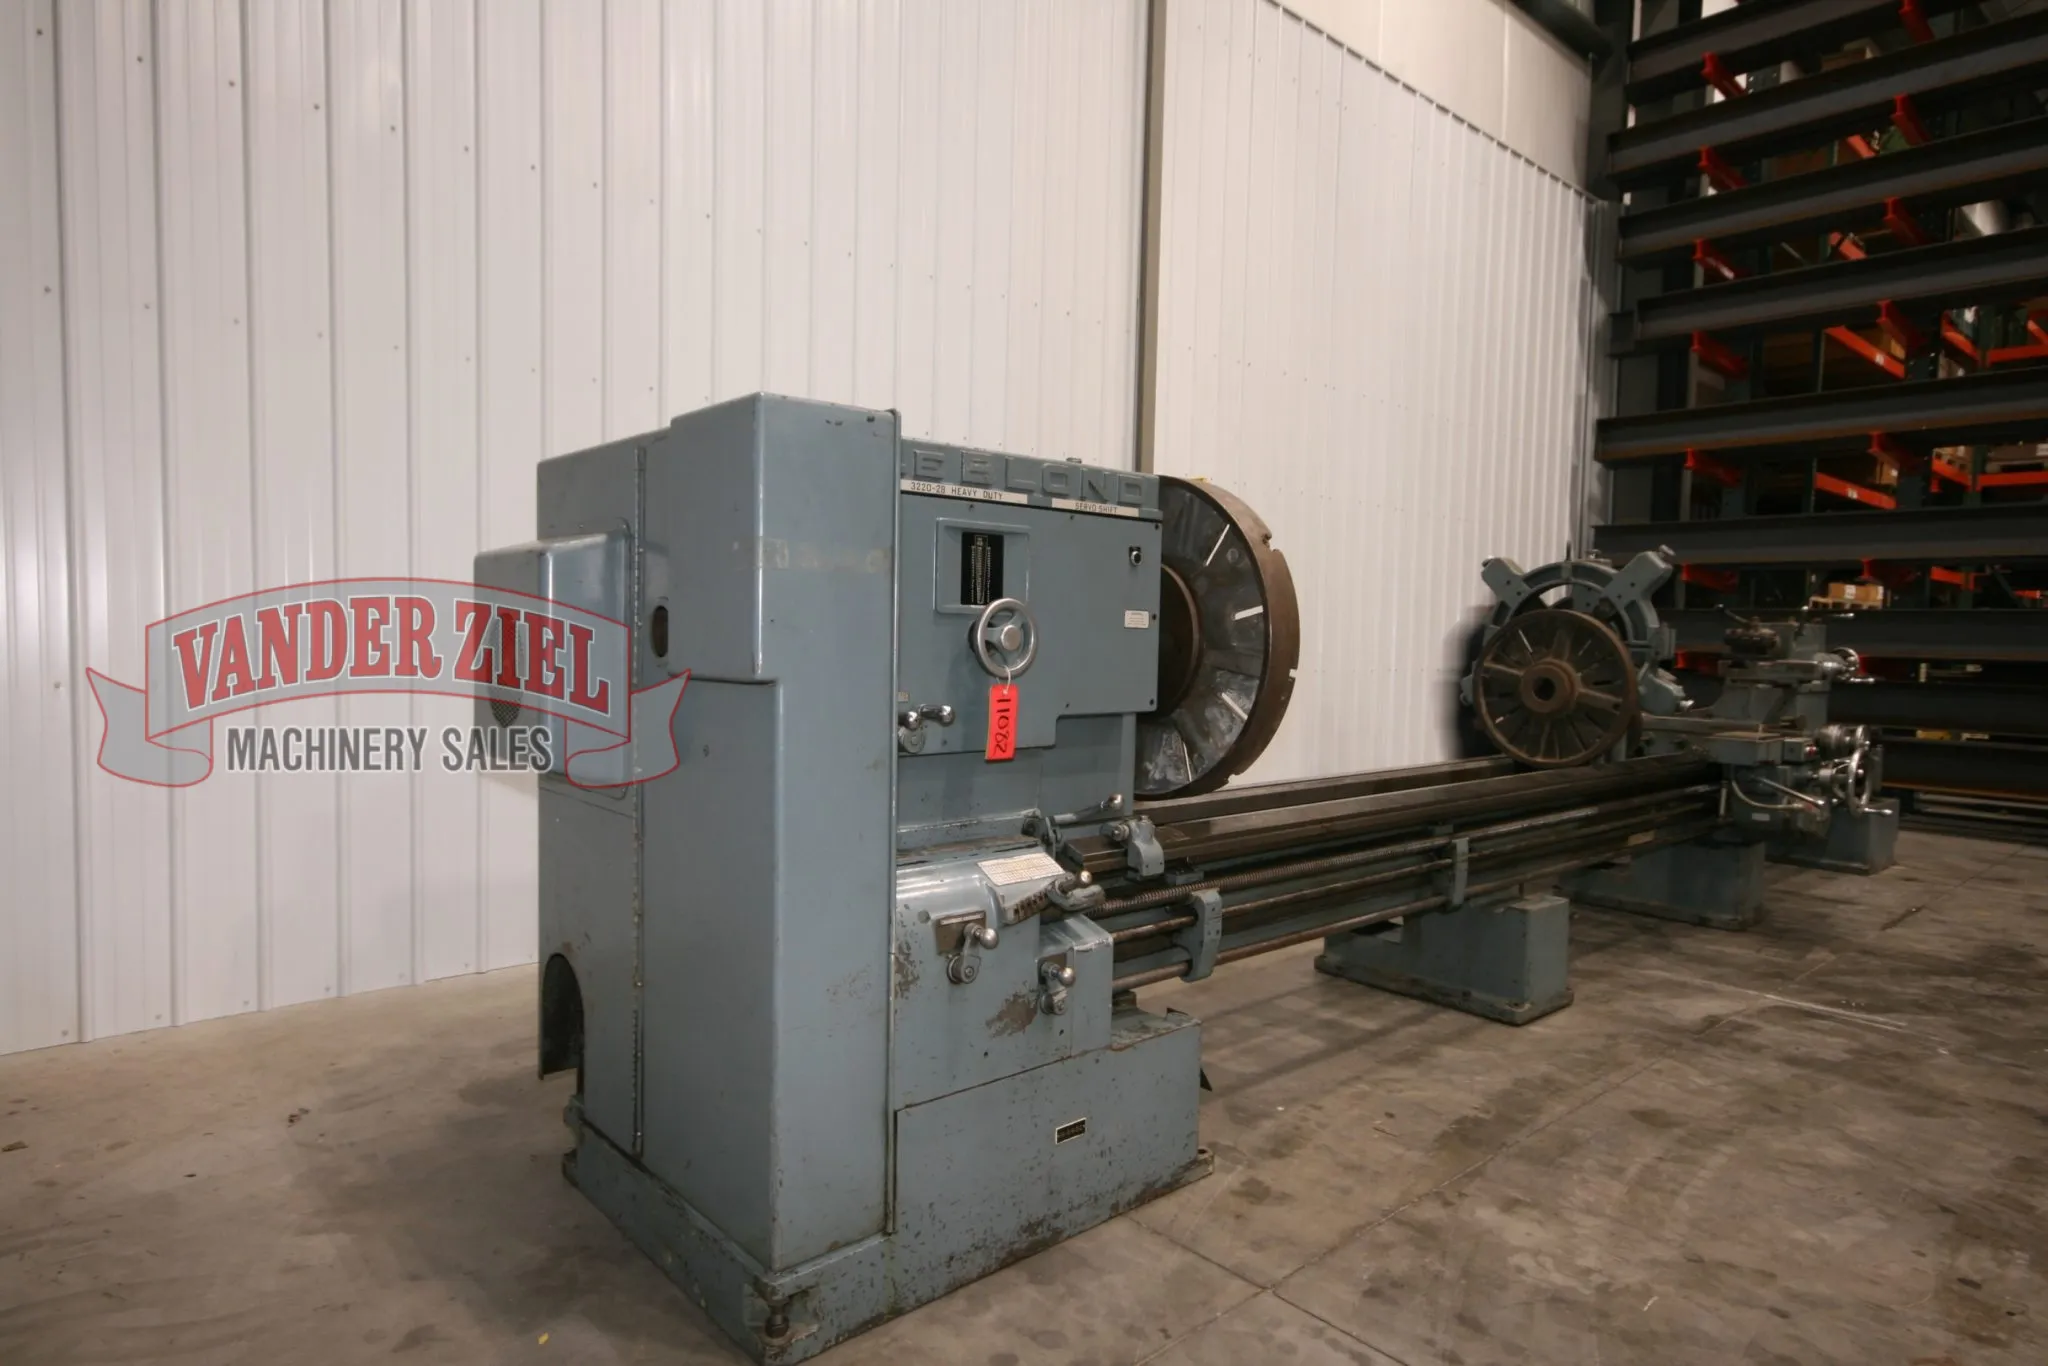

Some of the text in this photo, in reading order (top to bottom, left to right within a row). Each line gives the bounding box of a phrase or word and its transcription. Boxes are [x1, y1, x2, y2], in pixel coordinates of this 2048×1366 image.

[901, 449, 1143, 505] EBLOND
[951, 486, 977, 497] HEAVY
[983, 490, 1003, 501] DUTY
[1075, 502, 1118, 514] SERVO SHIFT
